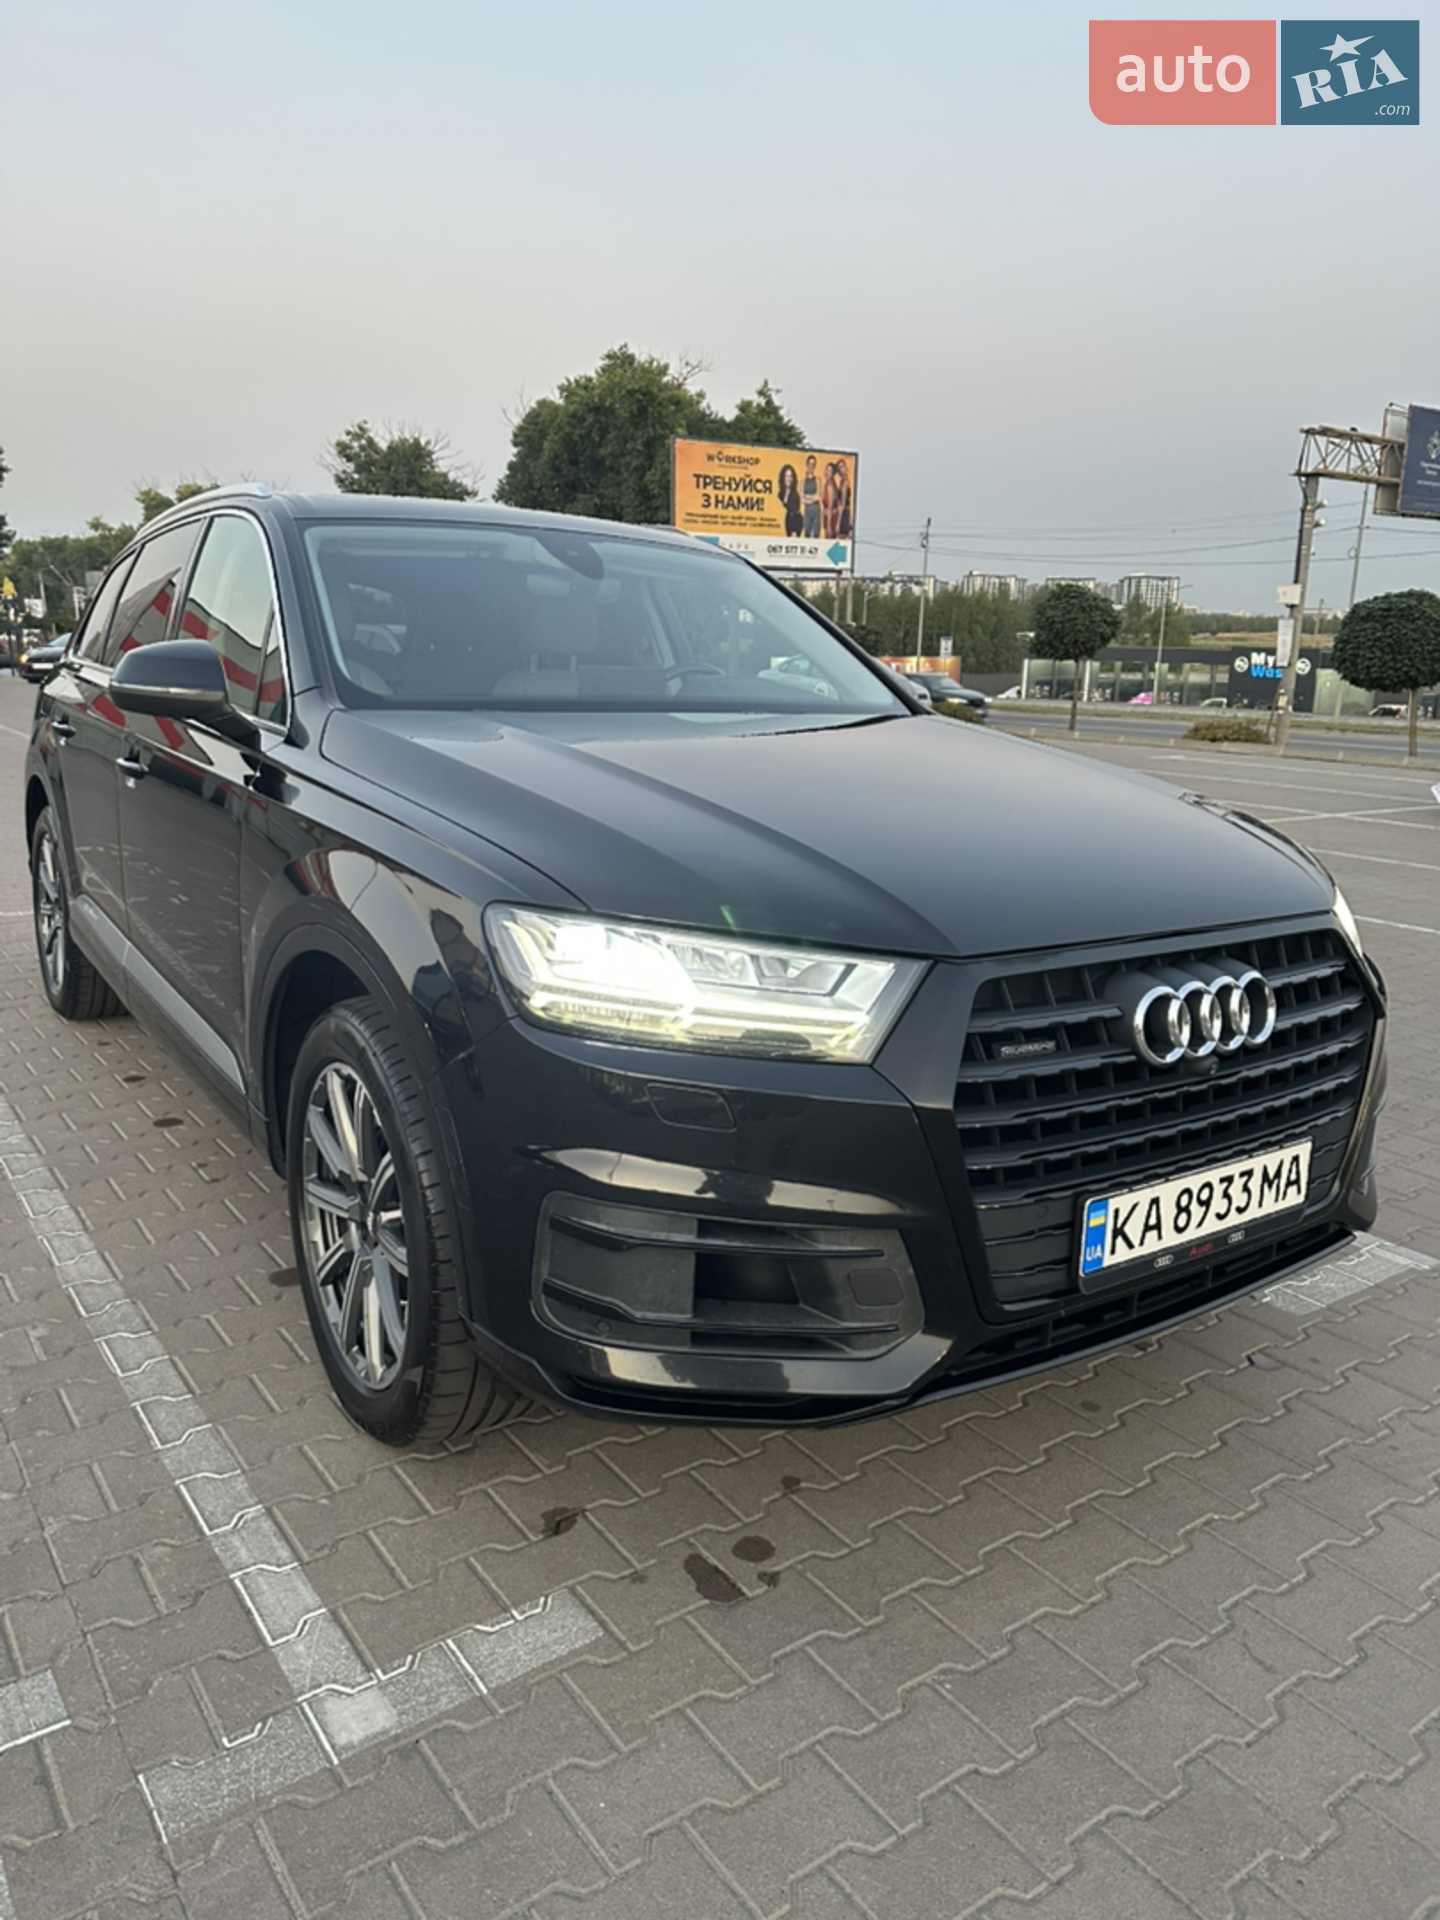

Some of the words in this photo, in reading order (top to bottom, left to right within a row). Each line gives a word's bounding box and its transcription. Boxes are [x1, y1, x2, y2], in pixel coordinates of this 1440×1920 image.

[693, 473, 773, 495] ТРЕНУЙСЯ
[714, 494, 765, 512] НАМИ!
[1251, 652, 1276, 669] My
[1250, 664, 1285, 679] Was
[1110, 1195, 1163, 1256] KA
[1172, 1167, 1255, 1235] 8933
[1258, 1153, 1302, 1209] MA
[1086, 1244, 1103, 1262] UA
